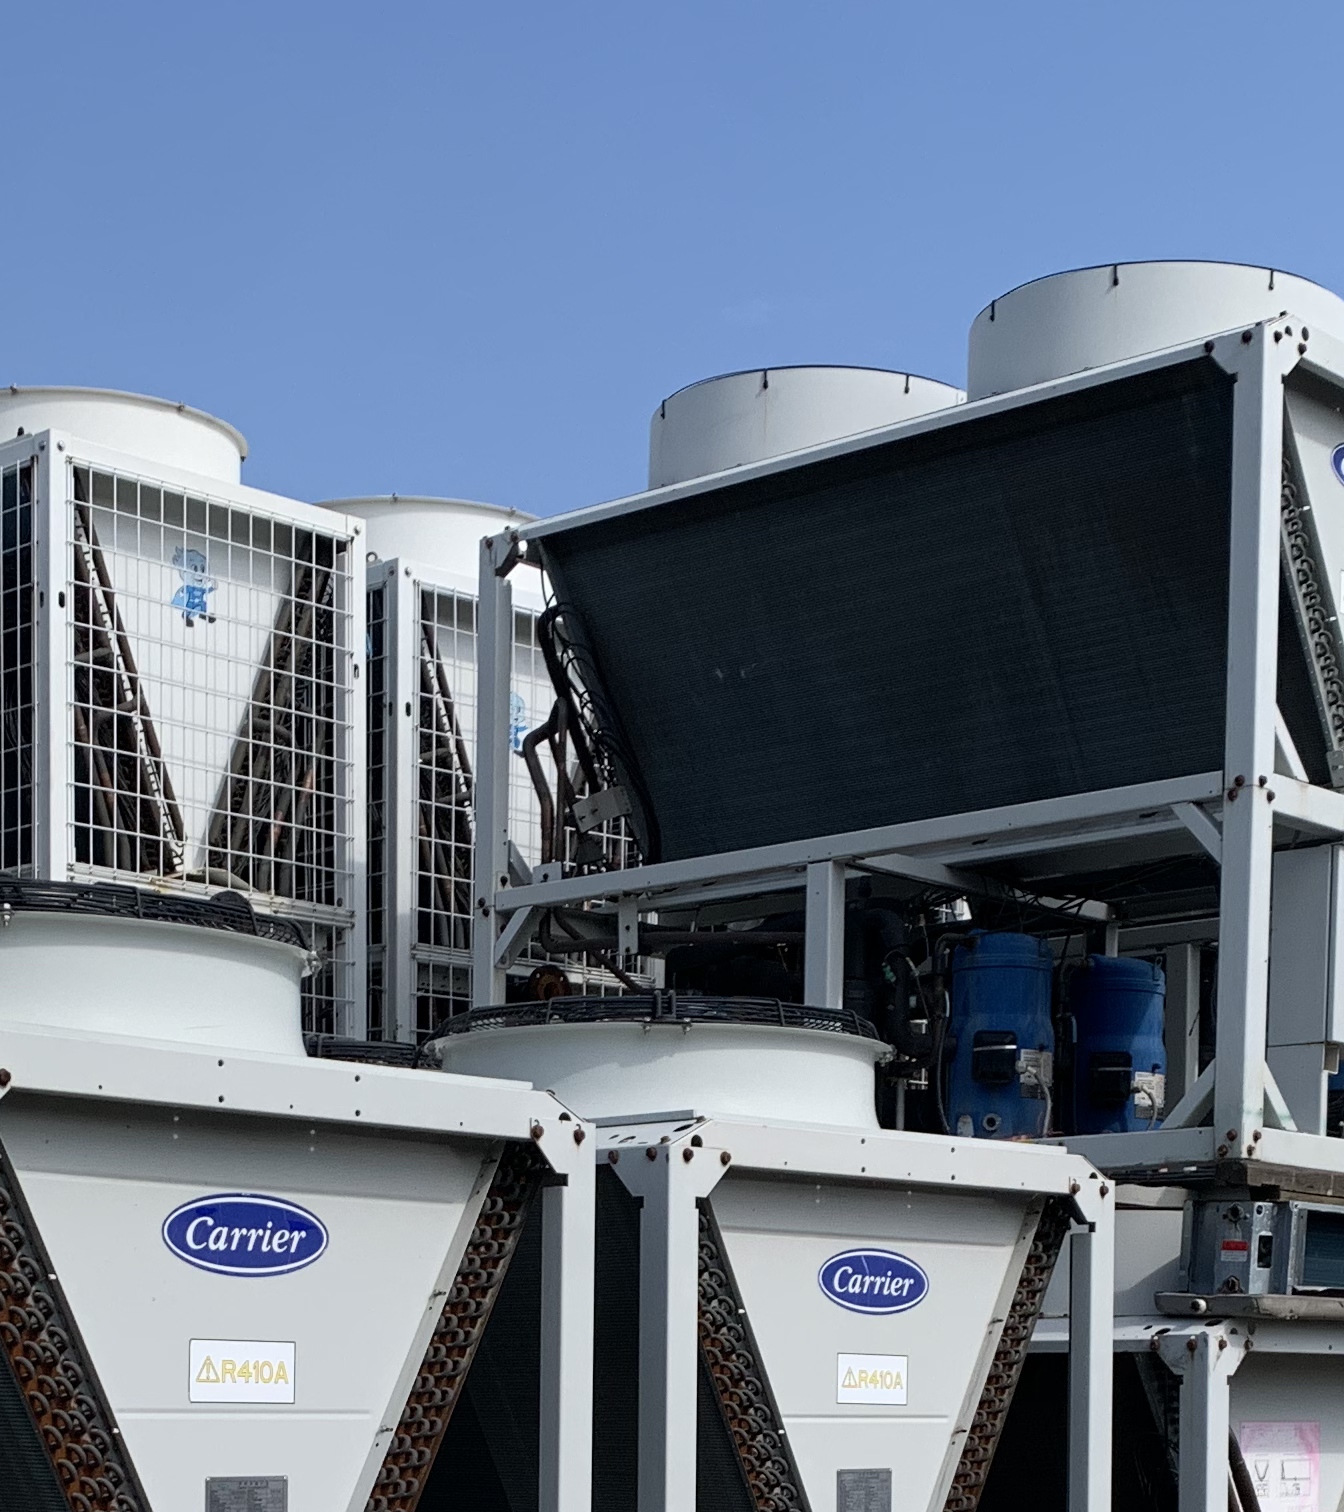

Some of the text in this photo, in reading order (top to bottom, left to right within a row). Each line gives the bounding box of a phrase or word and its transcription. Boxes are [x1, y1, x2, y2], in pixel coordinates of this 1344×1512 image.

[185, 1216, 307, 1254] Carrier
[833, 1265, 915, 1297] Carrier
[221, 1359, 290, 1385] R410A
[857, 1369, 904, 1390] R410A
